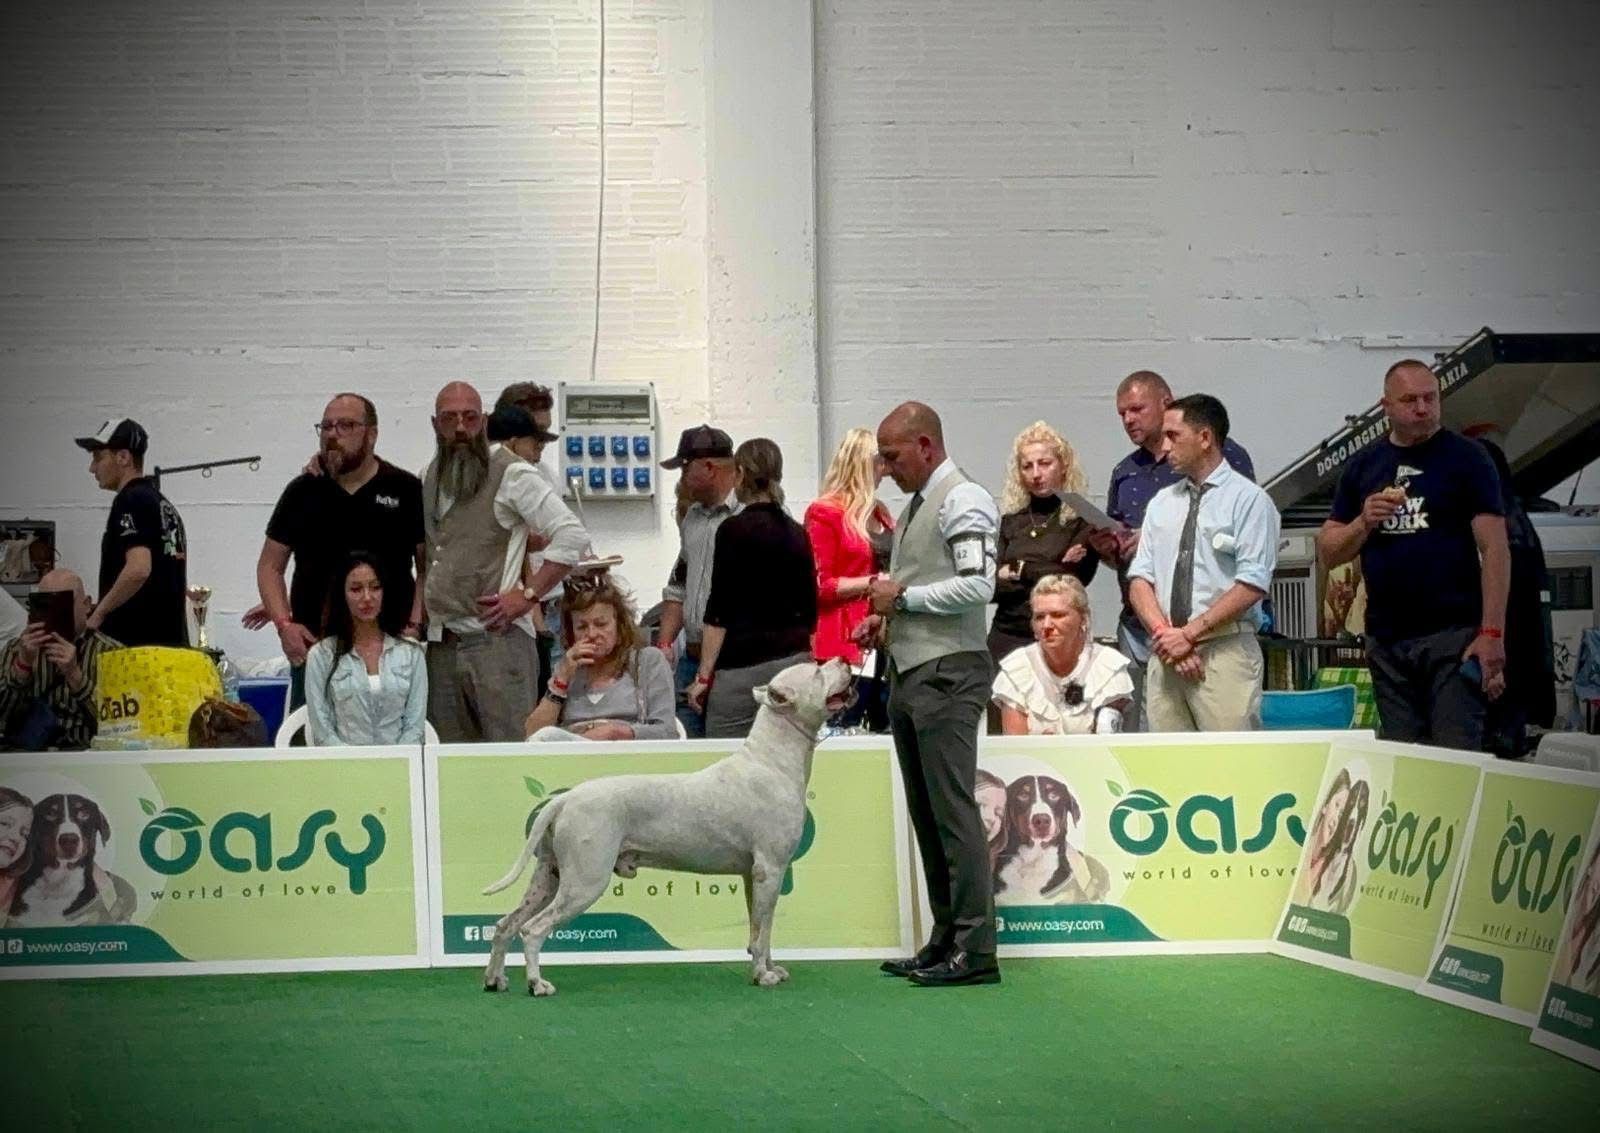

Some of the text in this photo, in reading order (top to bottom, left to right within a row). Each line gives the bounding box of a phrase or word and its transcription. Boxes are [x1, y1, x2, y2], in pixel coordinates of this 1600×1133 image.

[1348, 416, 1391, 455] ARGENT
[1440, 361, 1468, 392] AKIA
[1383, 513, 1430, 530] ORK
[139, 807, 386, 895] oasy
[1368, 801, 1454, 910] oasy
[1123, 867, 1192, 880] world
[1210, 866, 1232, 879] of
[1491, 815, 1581, 915] oas
[151, 883, 336, 900] world of love
[647, 881, 738, 896] of lov
[1008, 919, 1104, 933] www.oasy.com
[27, 940, 128, 954] www.oasy.com
